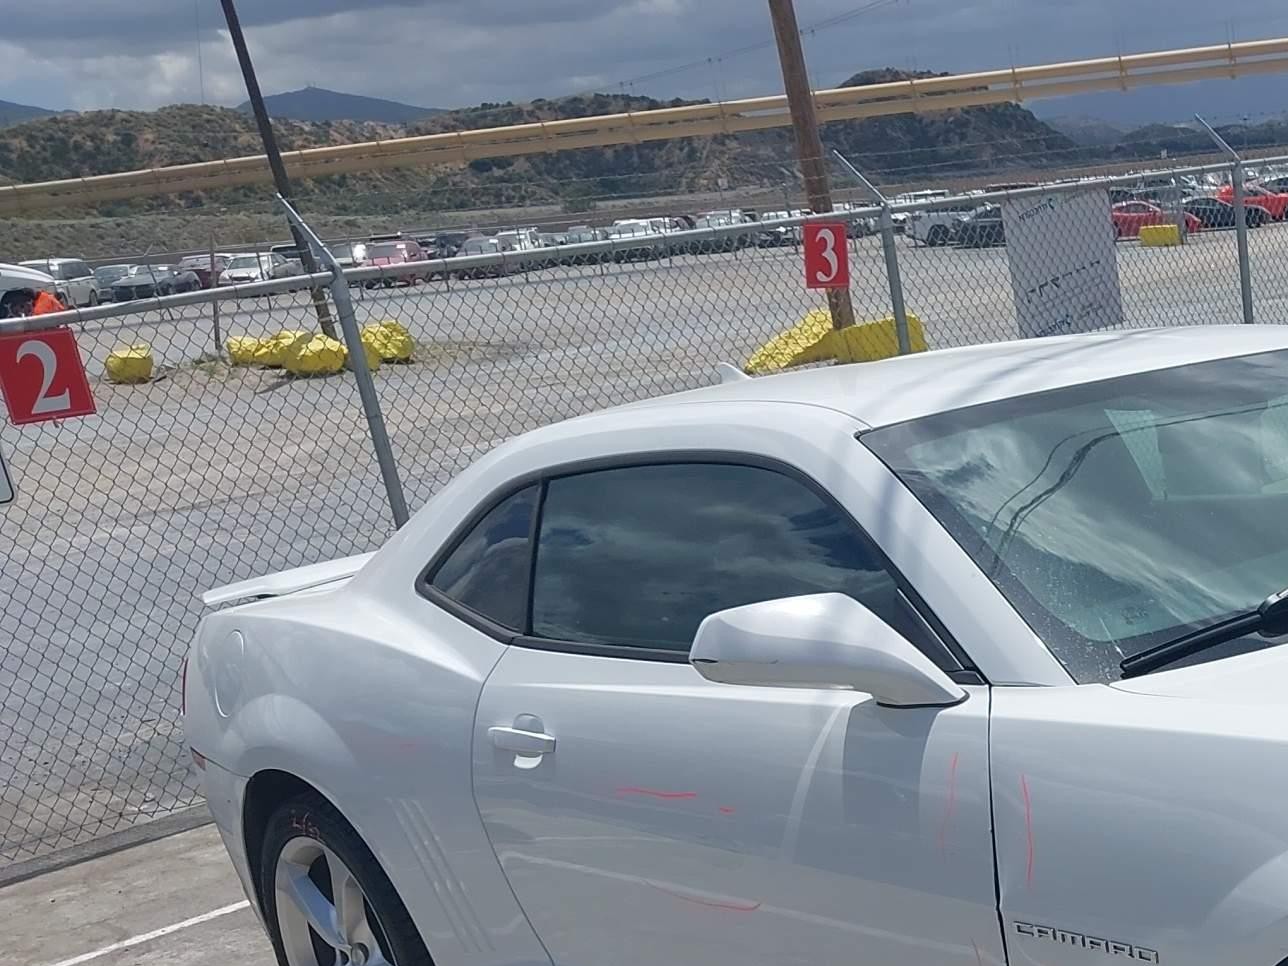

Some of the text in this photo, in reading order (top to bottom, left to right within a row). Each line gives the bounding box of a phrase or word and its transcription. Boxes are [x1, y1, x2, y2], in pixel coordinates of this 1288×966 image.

[815, 228, 838, 282] 3
[16, 340, 71, 414] 2
[1013, 921, 1160, 965] CAMARO
